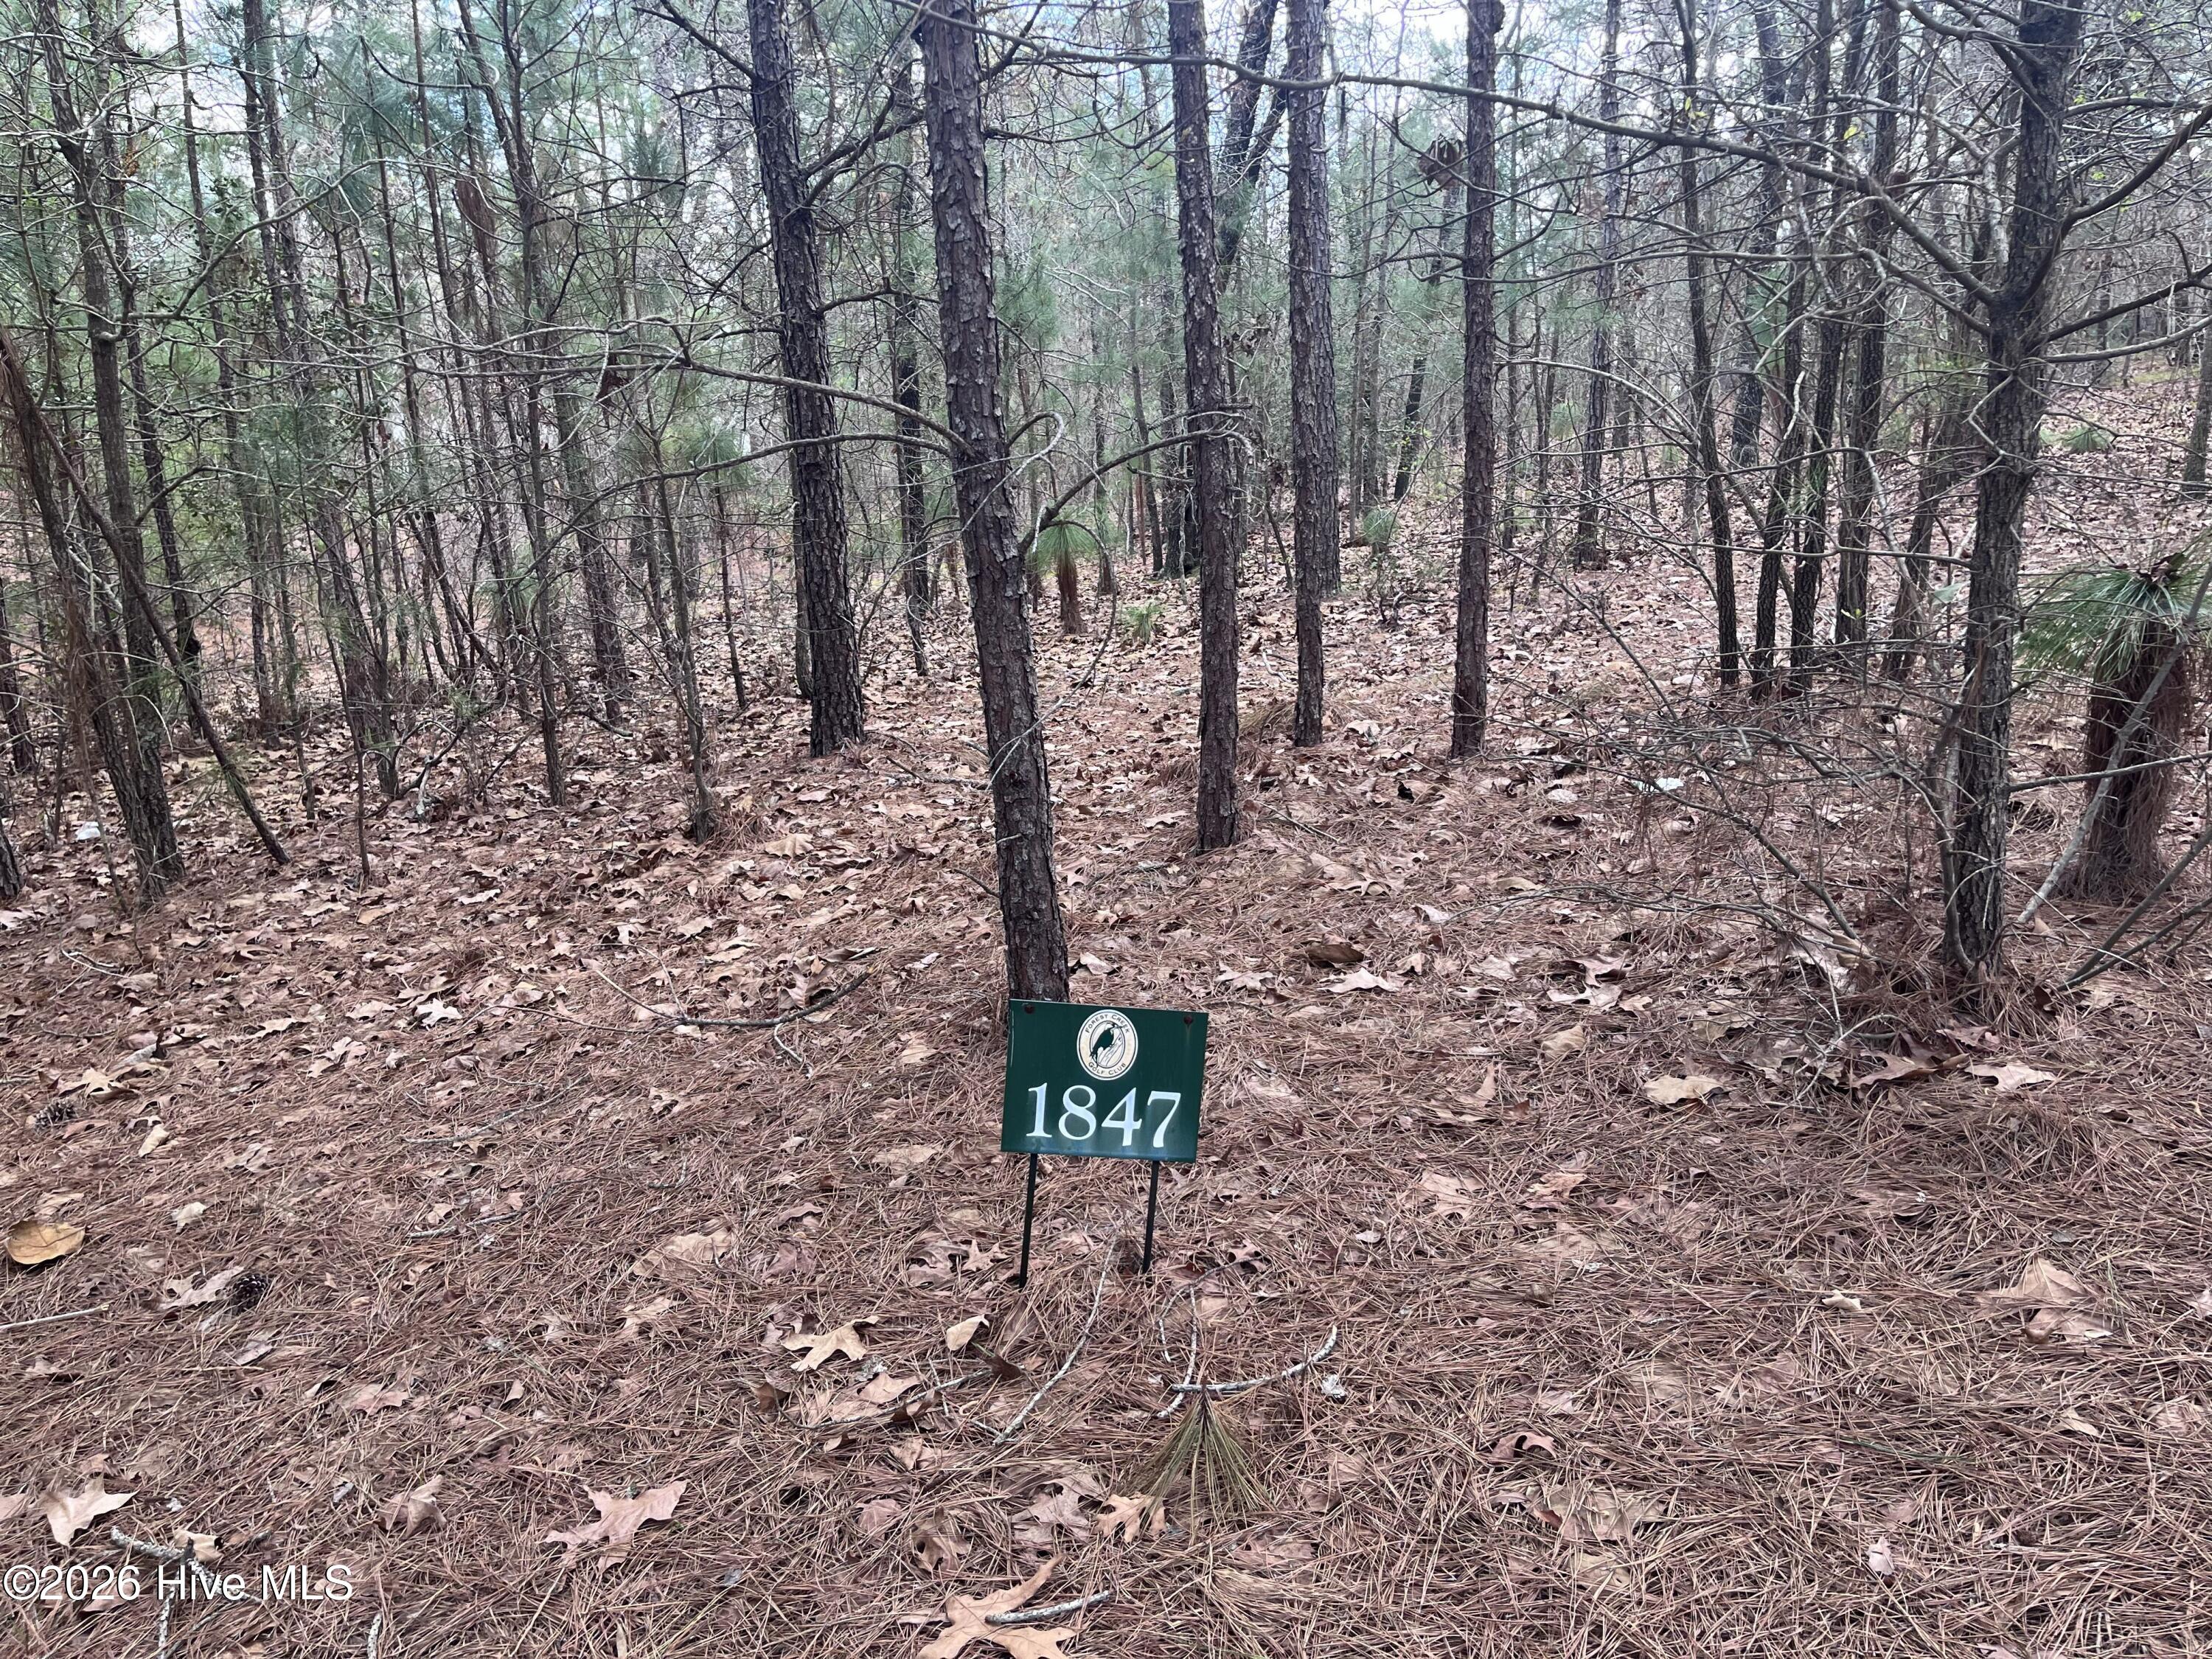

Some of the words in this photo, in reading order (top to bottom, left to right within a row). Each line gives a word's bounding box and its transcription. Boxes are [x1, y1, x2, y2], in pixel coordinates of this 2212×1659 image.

[1085, 1015, 1108, 1033] FOREST
[1111, 1014, 1130, 1033] CREEK
[1088, 1062, 1105, 1074] GOLF
[1108, 1062, 1126, 1075] CLUB
[1026, 1082, 1181, 1148] 1847
